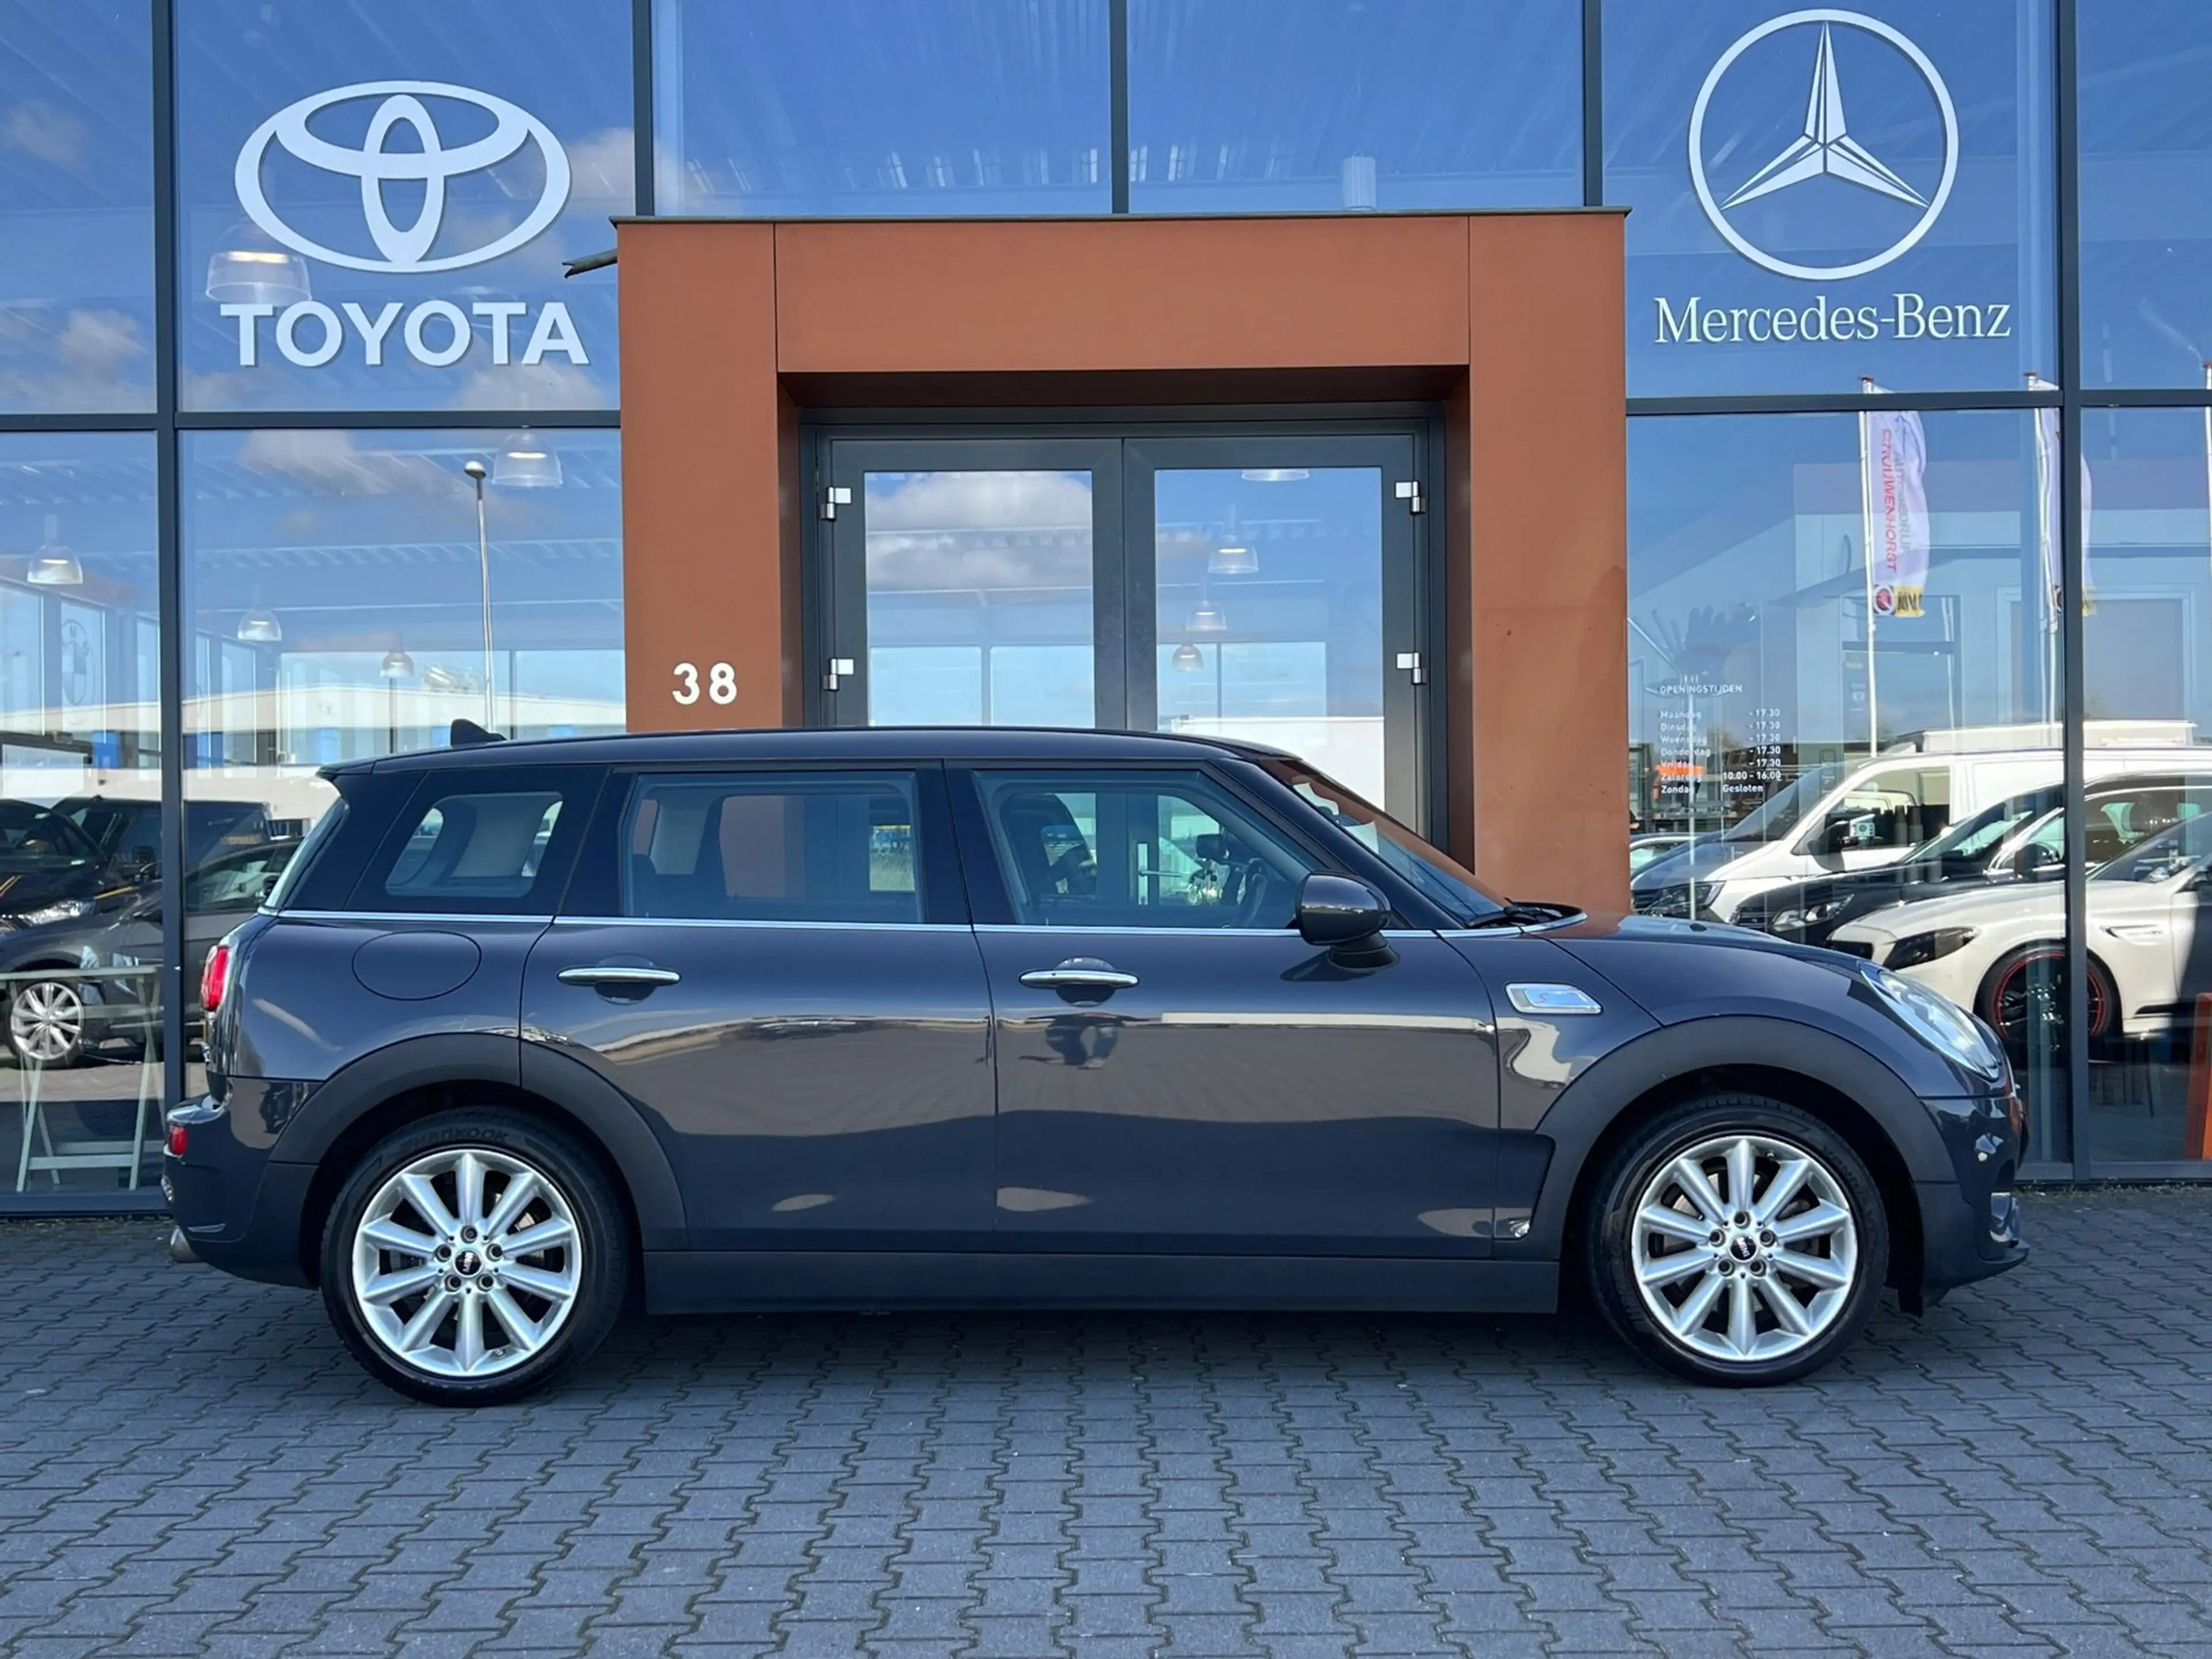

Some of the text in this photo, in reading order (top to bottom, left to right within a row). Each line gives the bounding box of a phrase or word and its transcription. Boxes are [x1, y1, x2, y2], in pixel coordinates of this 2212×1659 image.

[1654, 293, 2012, 343] Mercedes-Benz
[219, 300, 589, 367] TOYOTA
[672, 662, 737, 704] 38
[1660, 684, 1743, 694] OPENINGSTIJDEN
[1660, 711, 1701, 721] Maandag
[1660, 748, 1711, 757] Dondedag
[1756, 745, 1781, 755] 17.30
[1756, 758, 1781, 767] 17.30
[1723, 771, 1748, 780] 10.00
[1756, 771, 1782, 781] 16.00
[1661, 784, 1764, 794] Zondag Gesloten
